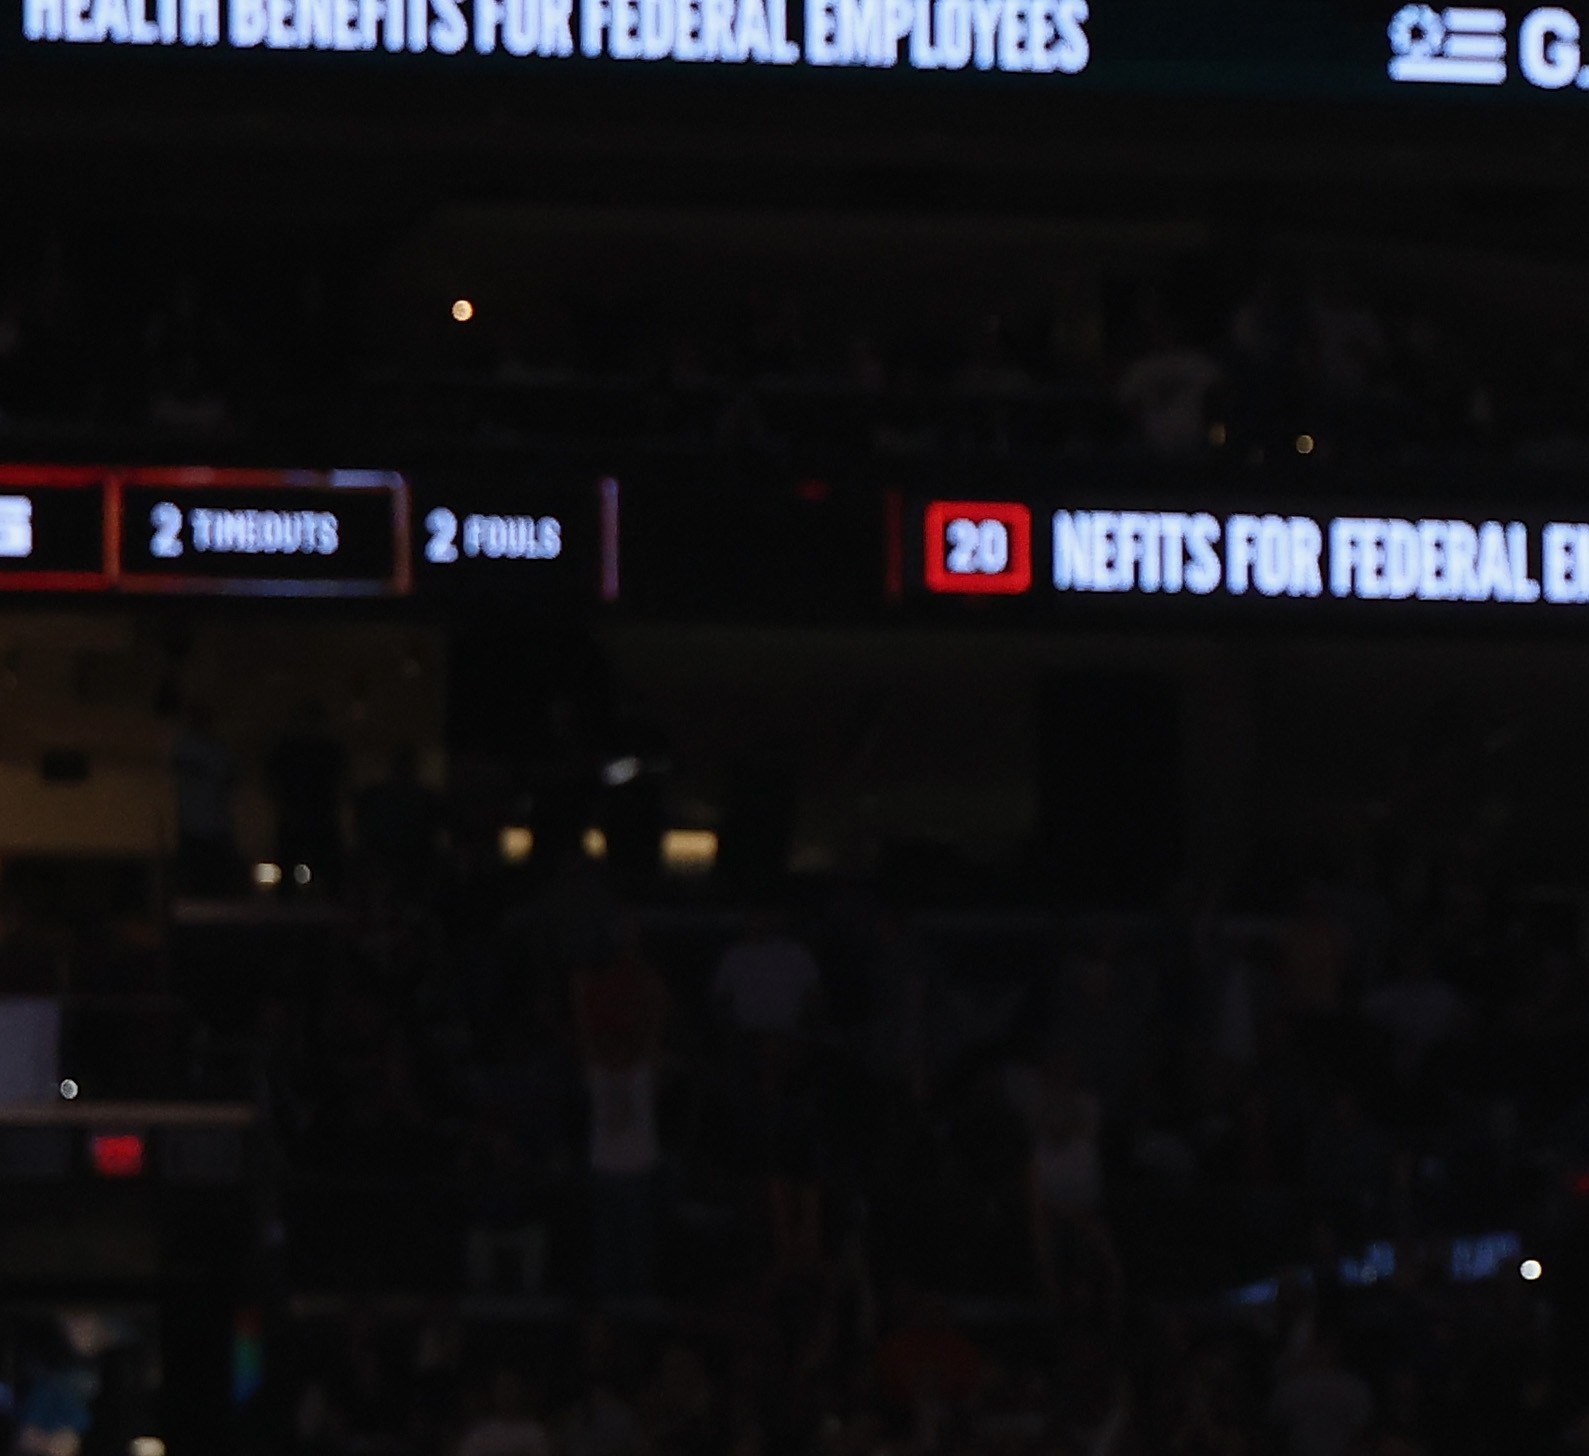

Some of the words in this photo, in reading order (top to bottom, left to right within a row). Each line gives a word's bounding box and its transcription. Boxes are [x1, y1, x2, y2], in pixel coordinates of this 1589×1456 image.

[579, 0, 800, 65] FEDERAL
[804, 0, 1091, 74] EMPLOYEES
[149, 501, 183, 558] 2
[190, 508, 339, 554] TIMEOUTS
[424, 507, 458, 563] 2
[463, 514, 562, 560] FOULS
[945, 518, 1008, 574] 20
[1052, 510, 1221, 594] NEFITS
[1225, 514, 1323, 598] FOR
[1328, 517, 1541, 601] FEDERAL
